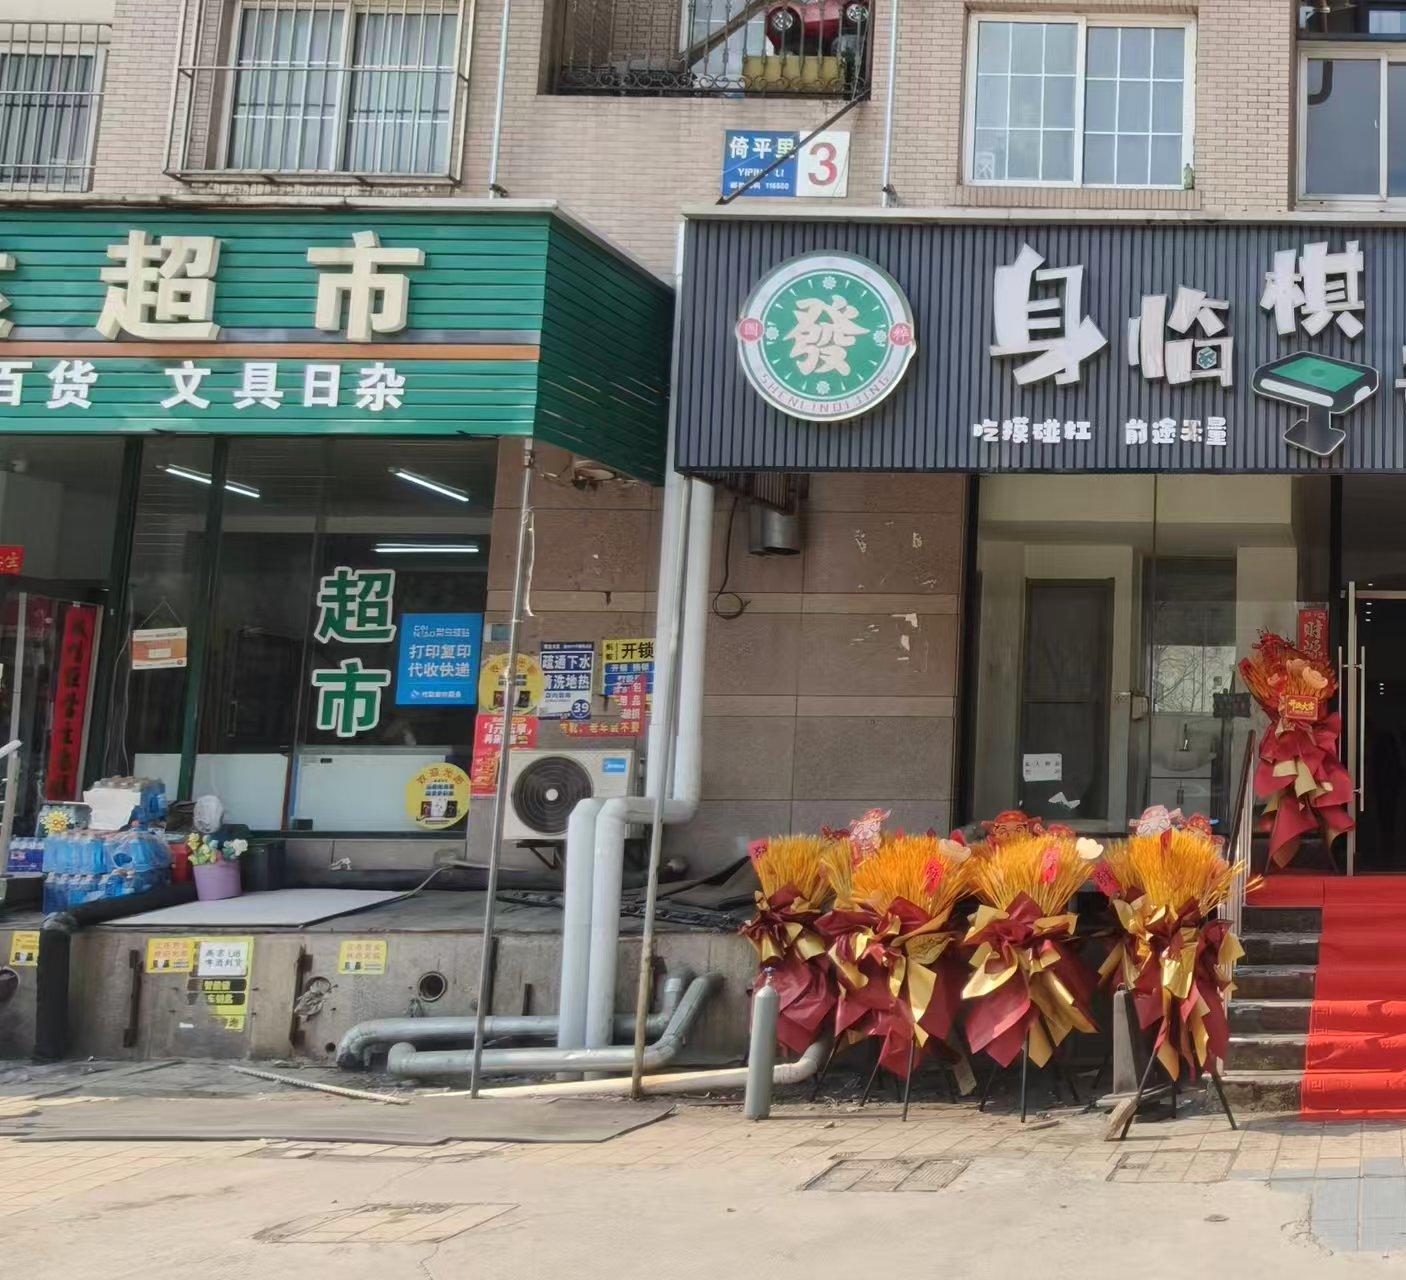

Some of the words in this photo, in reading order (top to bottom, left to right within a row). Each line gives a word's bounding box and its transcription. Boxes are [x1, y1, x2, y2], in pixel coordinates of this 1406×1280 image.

[729, 136, 794, 159] 倚平里
[807, 142, 838, 186] 3
[0, 230, 425, 341] 超市
[783, 294, 871, 377] 發
[160, 360, 406, 411] 文具日杂
[973, 417, 1091, 443] 吃摸碰杠
[312, 567, 397, 737] 超市
[408, 644, 471, 659] 打印复印
[542, 653, 591, 669] 疏通下水
[621, 641, 654, 659] 开锁
[407, 661, 470, 677] 代收快递
[573, 702, 590, 713] 39
